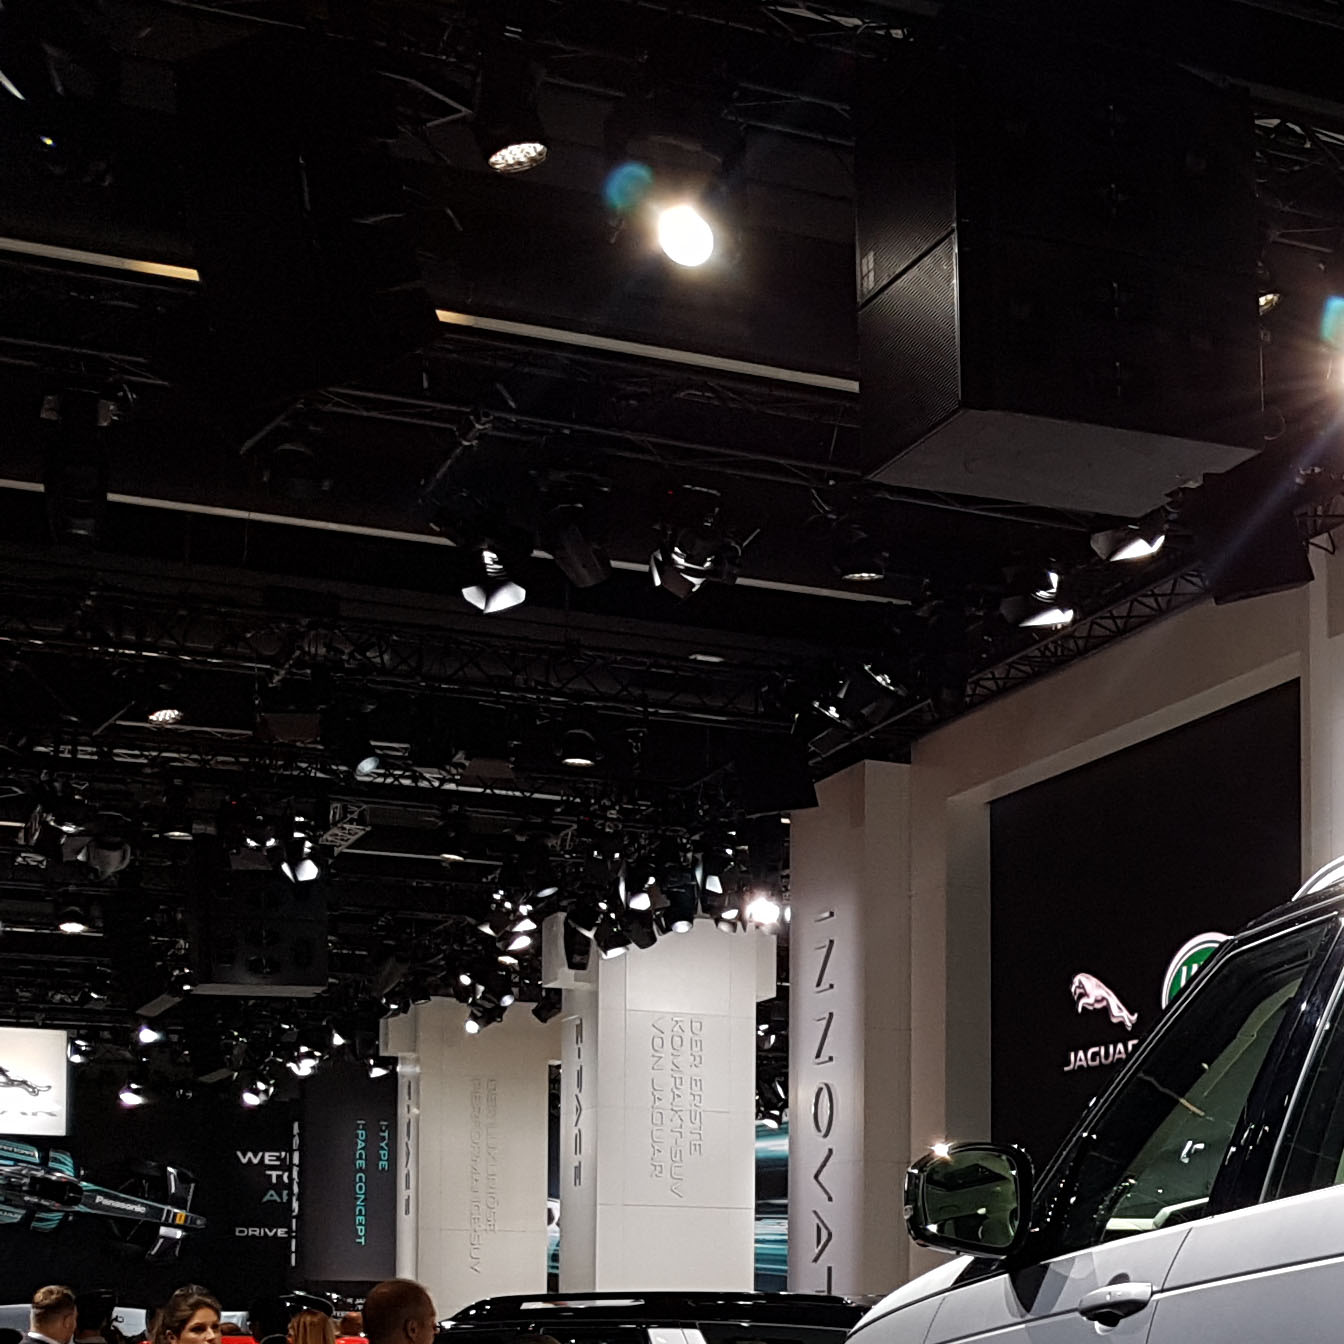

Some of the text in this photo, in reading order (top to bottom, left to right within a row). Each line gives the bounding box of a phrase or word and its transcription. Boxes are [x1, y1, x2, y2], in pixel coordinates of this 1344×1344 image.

[378, 1120, 390, 1172] I-TYPE
[650, 1017, 665, 1179] VON JAGUAR
[670, 1016, 686, 1199] KOMPAKT-SUV
[689, 1017, 703, 1157] DER ERSTE
[235, 1151, 290, 1165] WE'
[355, 1119, 367, 1246] I-PACE CONCEPT
